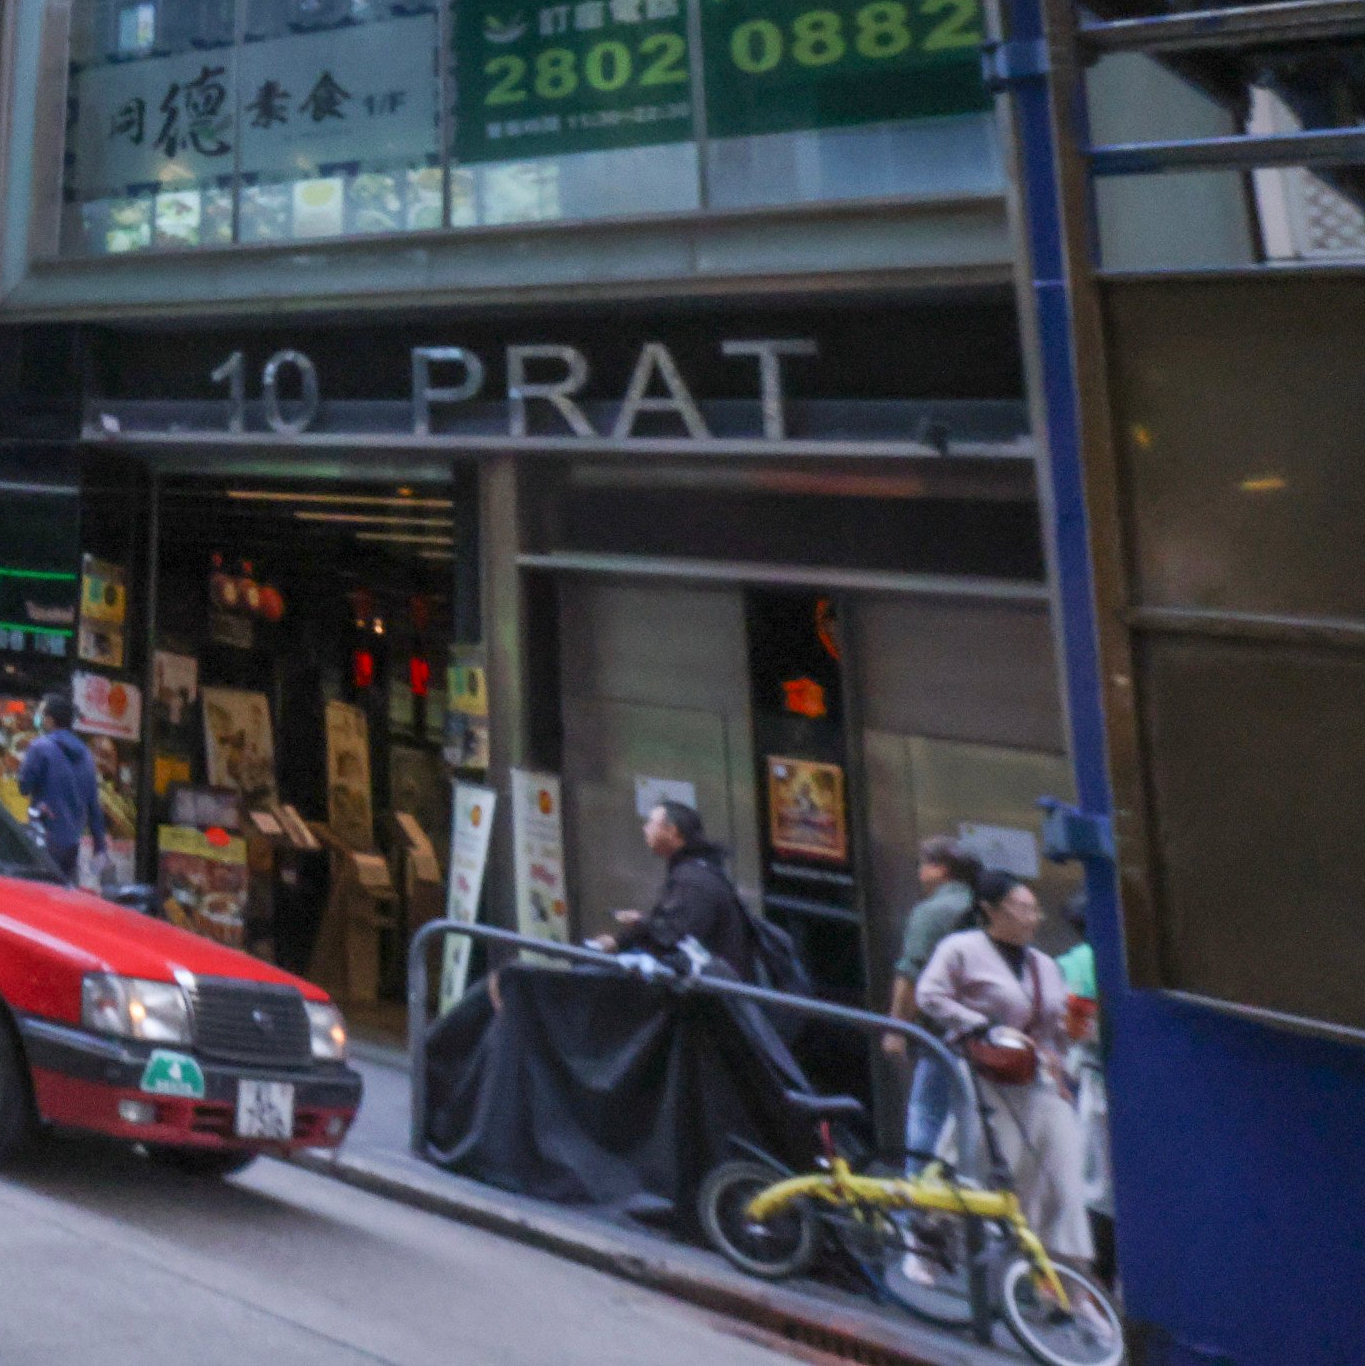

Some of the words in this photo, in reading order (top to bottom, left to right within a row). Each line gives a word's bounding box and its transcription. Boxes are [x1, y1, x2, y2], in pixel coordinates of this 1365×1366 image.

[483, 33, 689, 107] 2802
[209, 347, 322, 435] 10
[409, 337, 820, 439] PRAT
